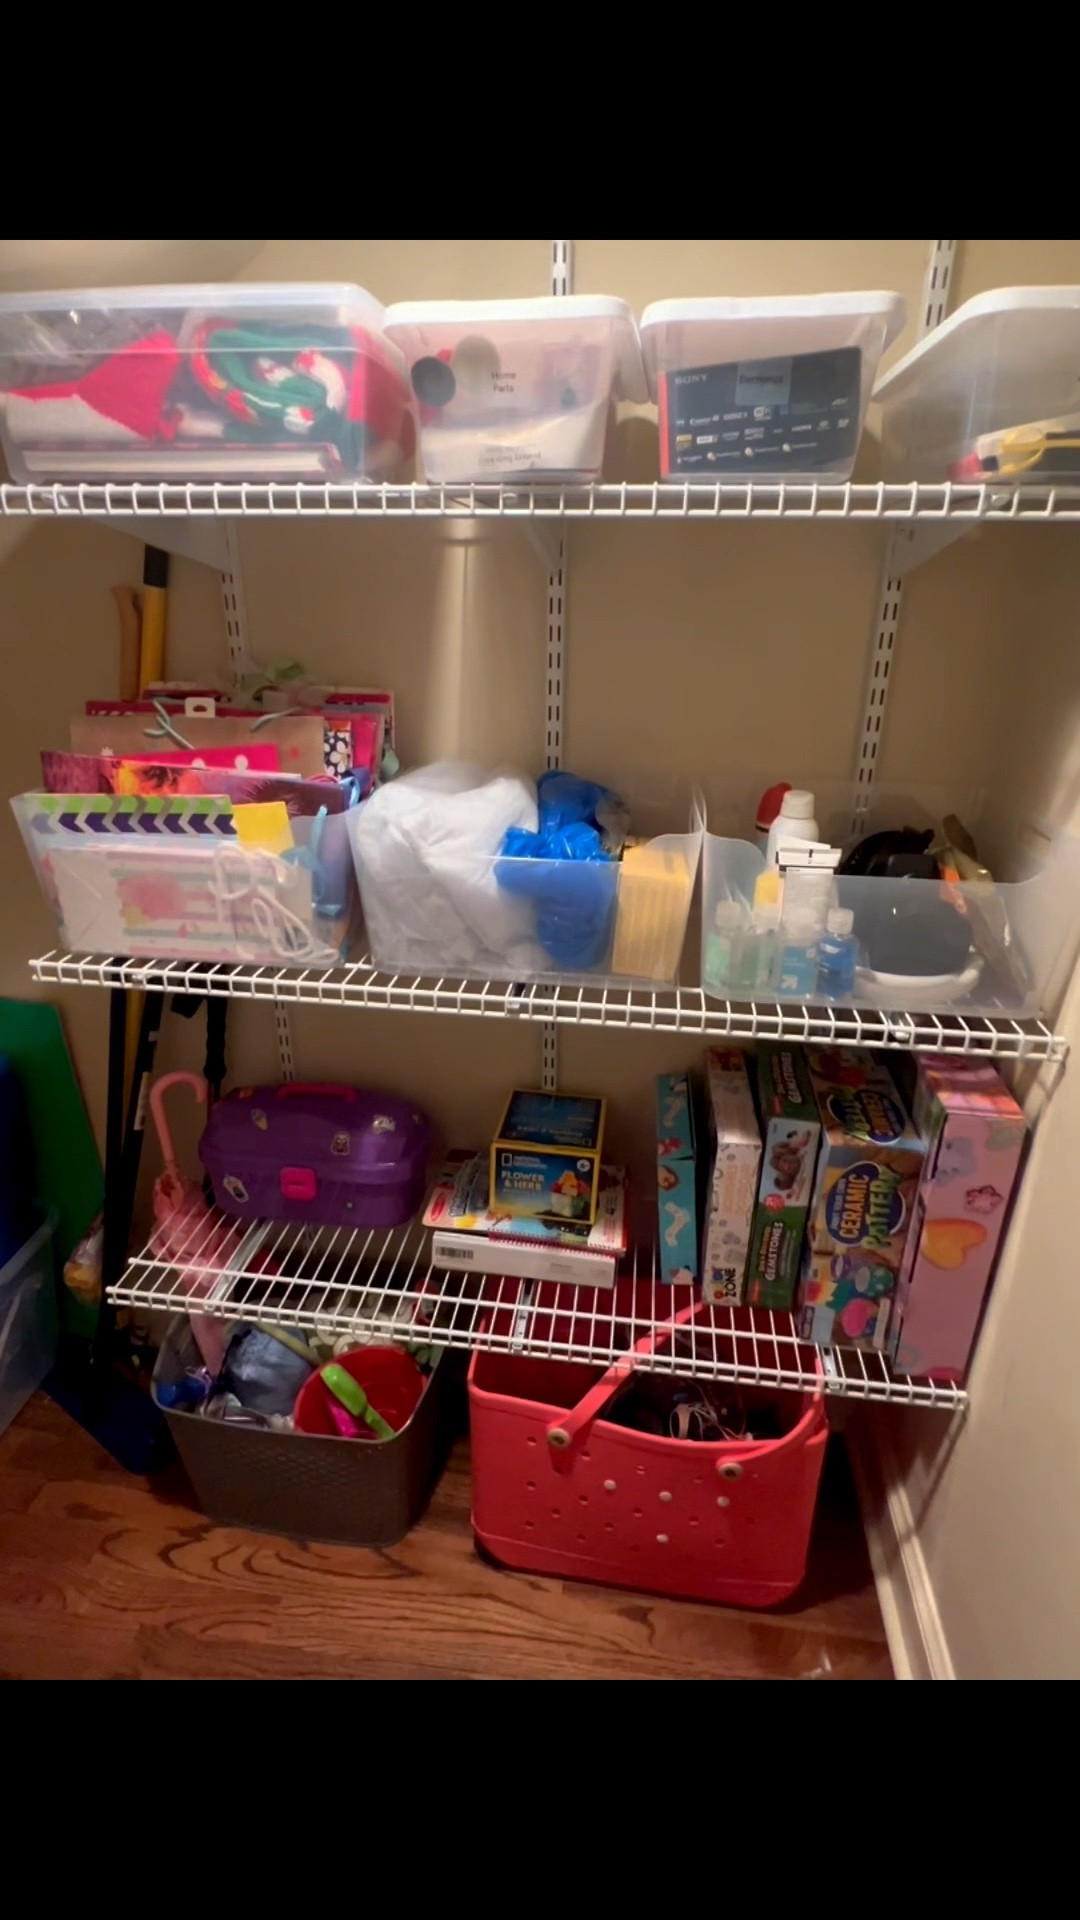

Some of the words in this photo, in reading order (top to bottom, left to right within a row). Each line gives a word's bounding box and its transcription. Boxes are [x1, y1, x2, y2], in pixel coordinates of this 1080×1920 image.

[491, 372, 517, 380] Home
[674, 373, 708, 385] SONY
[493, 383, 514, 393] Parts
[501, 1170, 545, 1182] FLOWER
[840, 1174, 870, 1238] CERAMIC
[764, 1221, 784, 1280] GEMSTONES
[724, 1268, 736, 1297] ZONE
